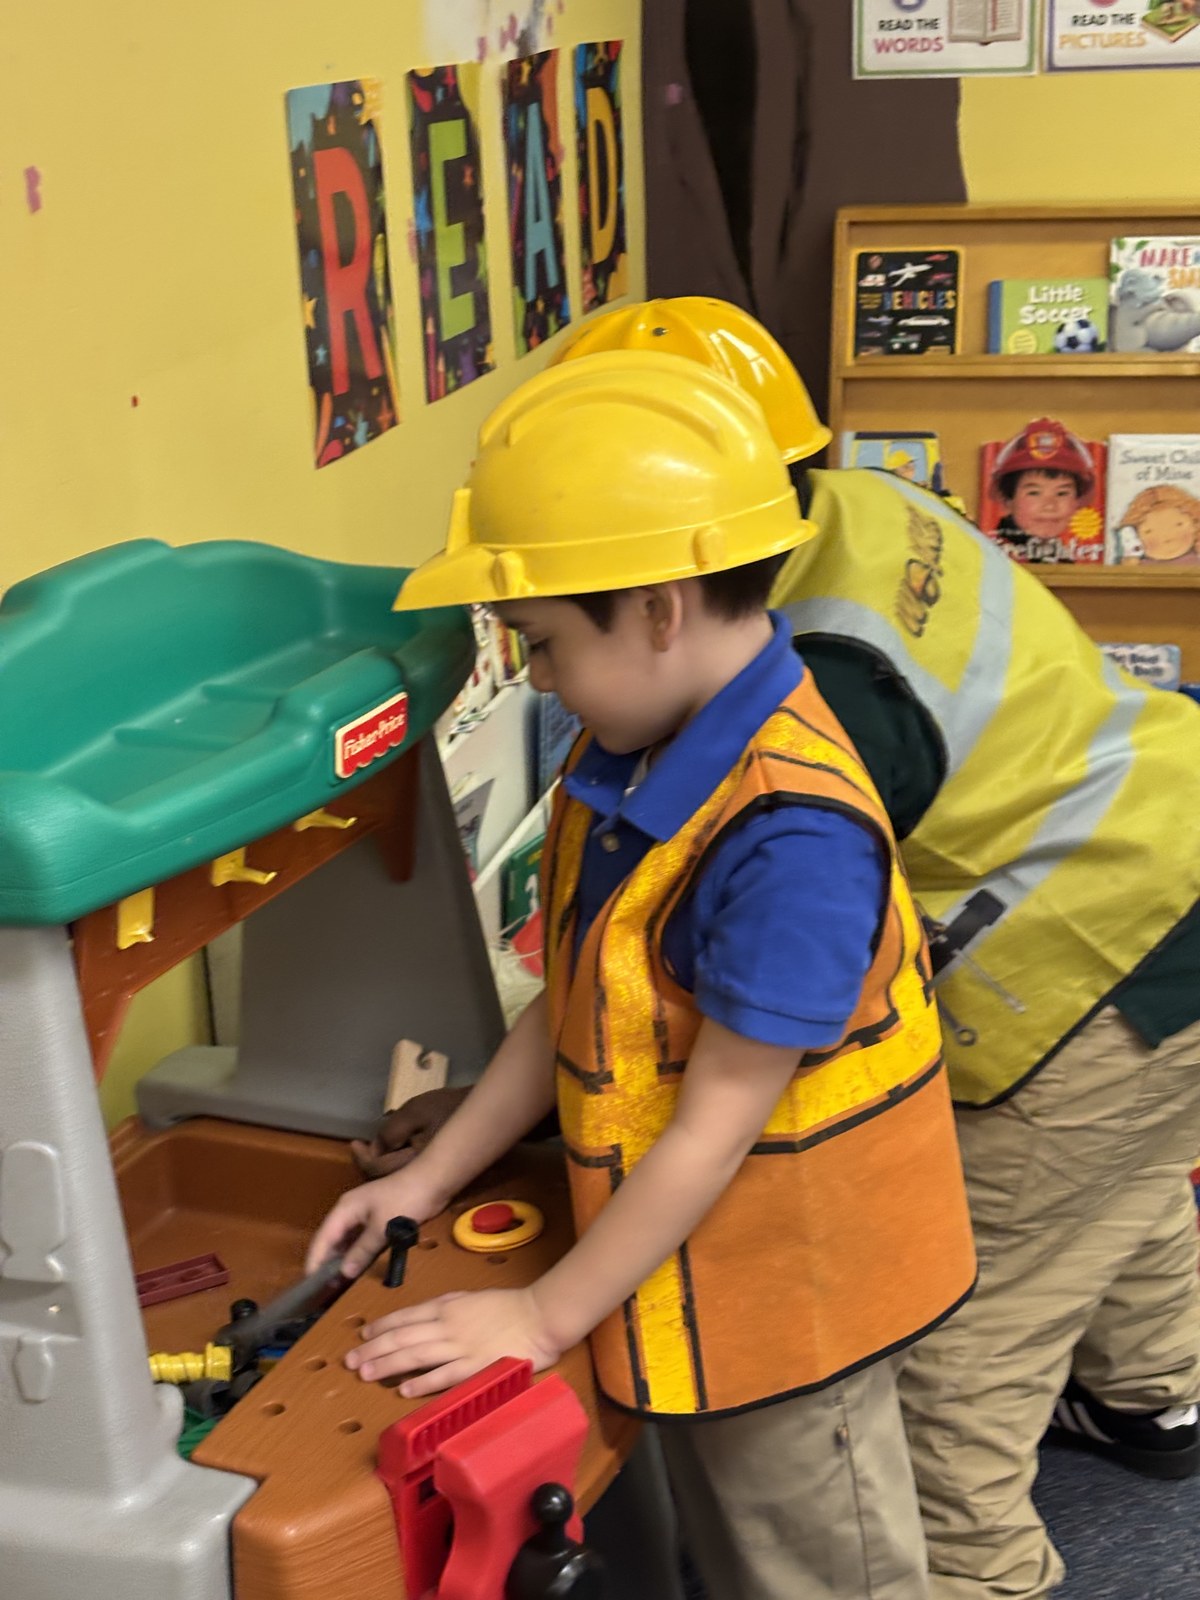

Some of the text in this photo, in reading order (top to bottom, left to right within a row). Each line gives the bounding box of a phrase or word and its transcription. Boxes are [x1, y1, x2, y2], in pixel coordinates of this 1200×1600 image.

[878, 17, 939, 31] READ THE
[1071, 13, 1135, 26] READ THE
[874, 37, 944, 54] WORDS
[1058, 31, 1147, 49] PICTURES
[312, 86, 617, 397] READ
[1029, 284, 1083, 304] Little
[1019, 304, 1093, 326] Soccer
[1119, 449, 1168, 465] Sweet
[1136, 465, 1152, 481] of
